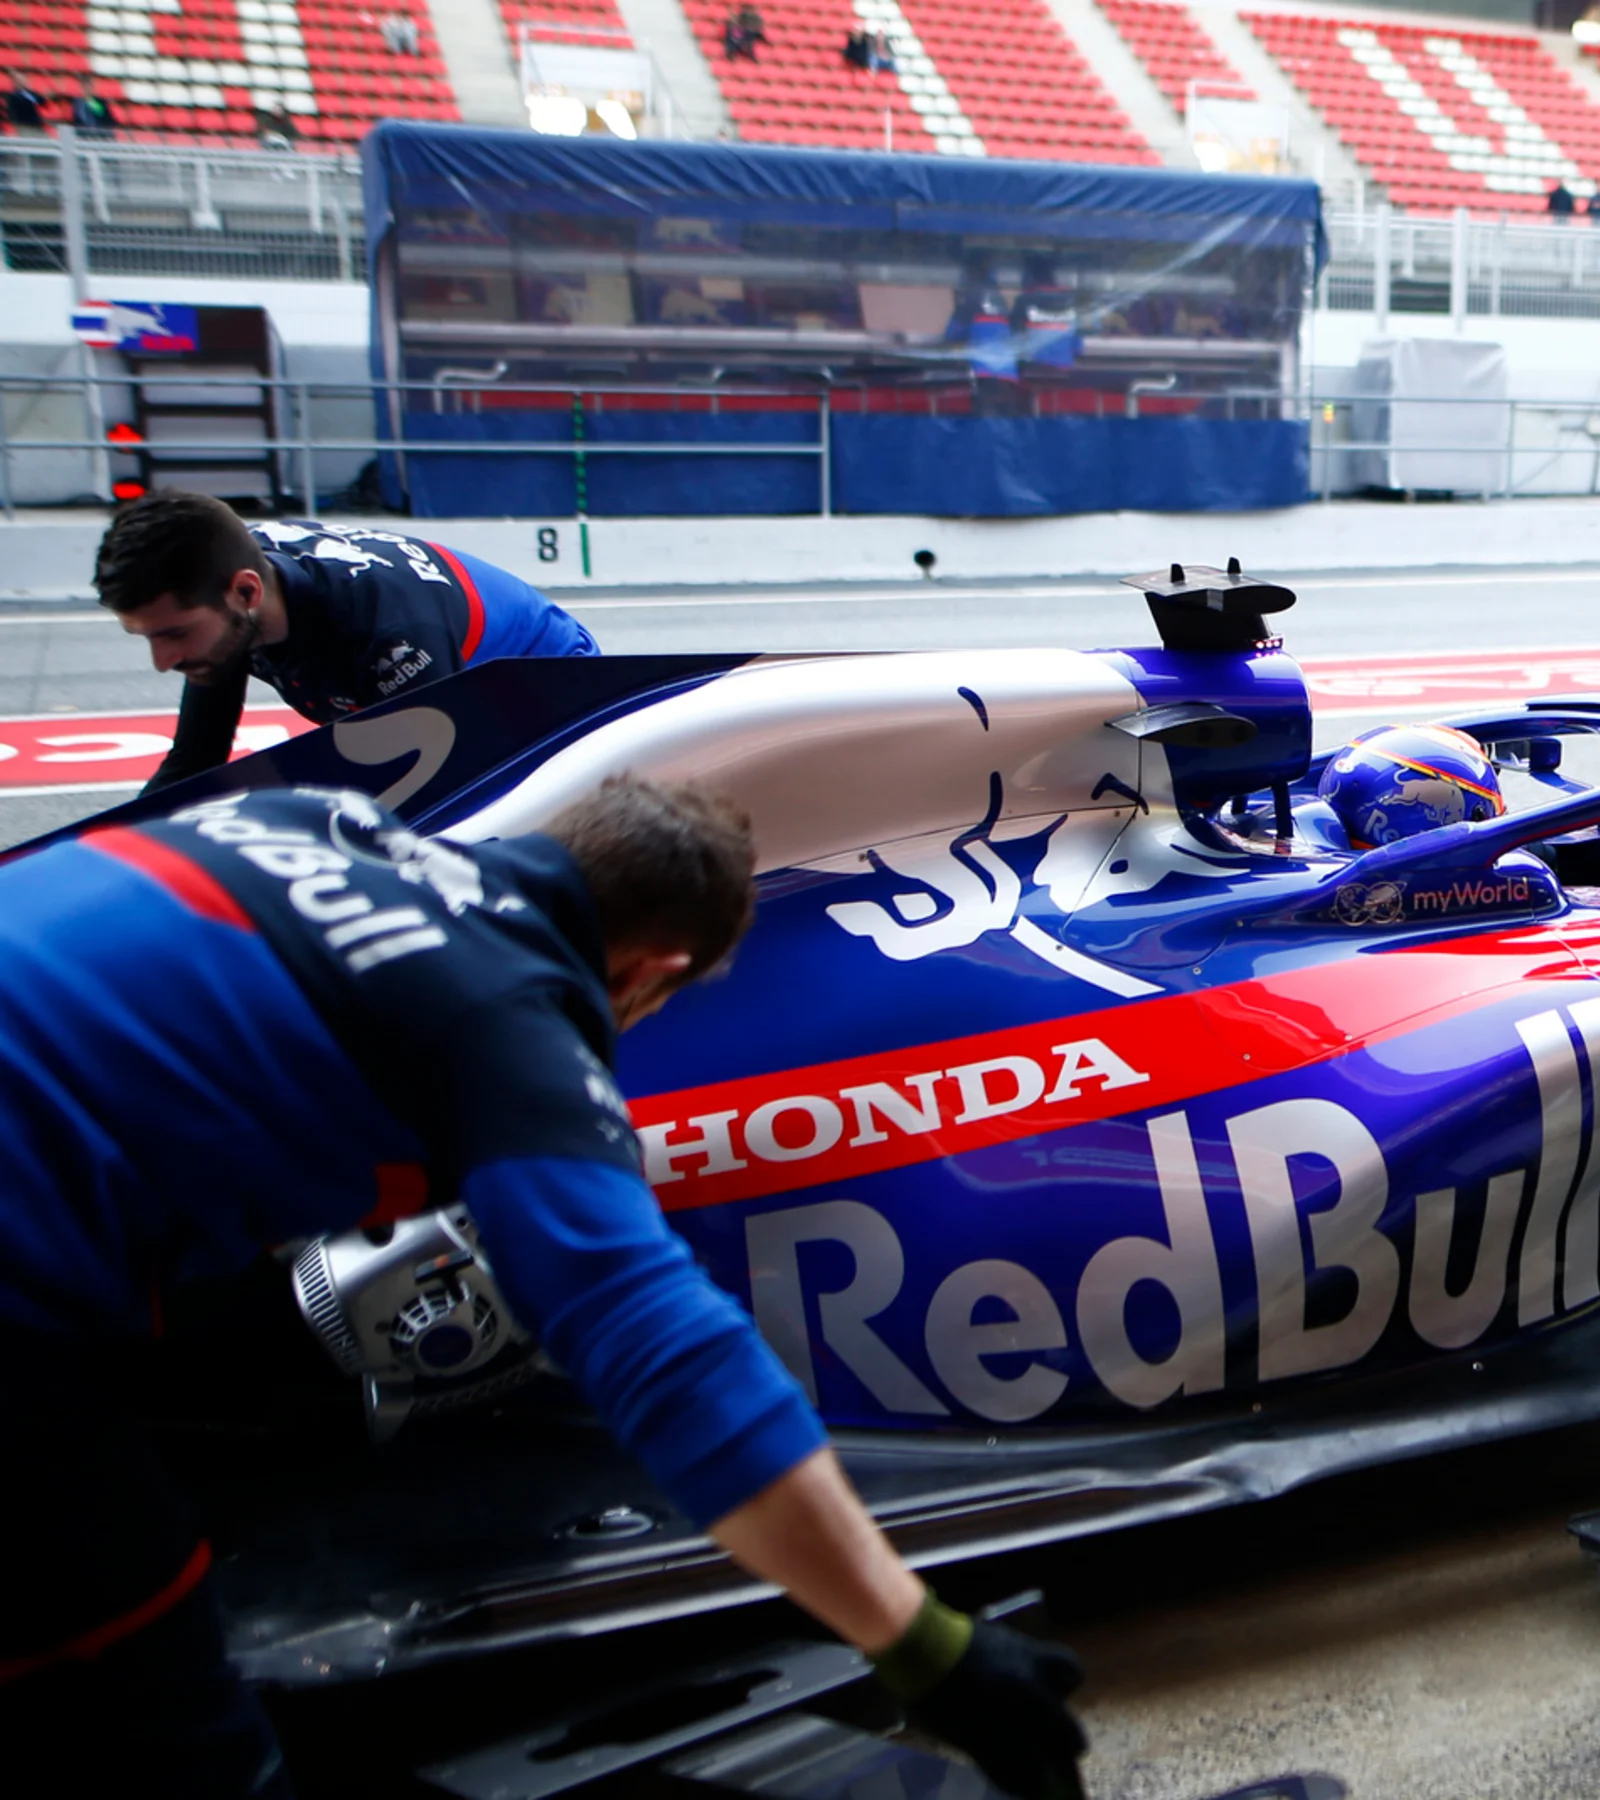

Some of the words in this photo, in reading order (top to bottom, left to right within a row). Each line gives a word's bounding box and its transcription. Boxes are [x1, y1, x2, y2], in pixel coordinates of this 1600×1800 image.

[537, 527, 557, 562] 8
[1413, 876, 1530, 912] myWorld
[635, 1038, 1151, 1186] HONDA
